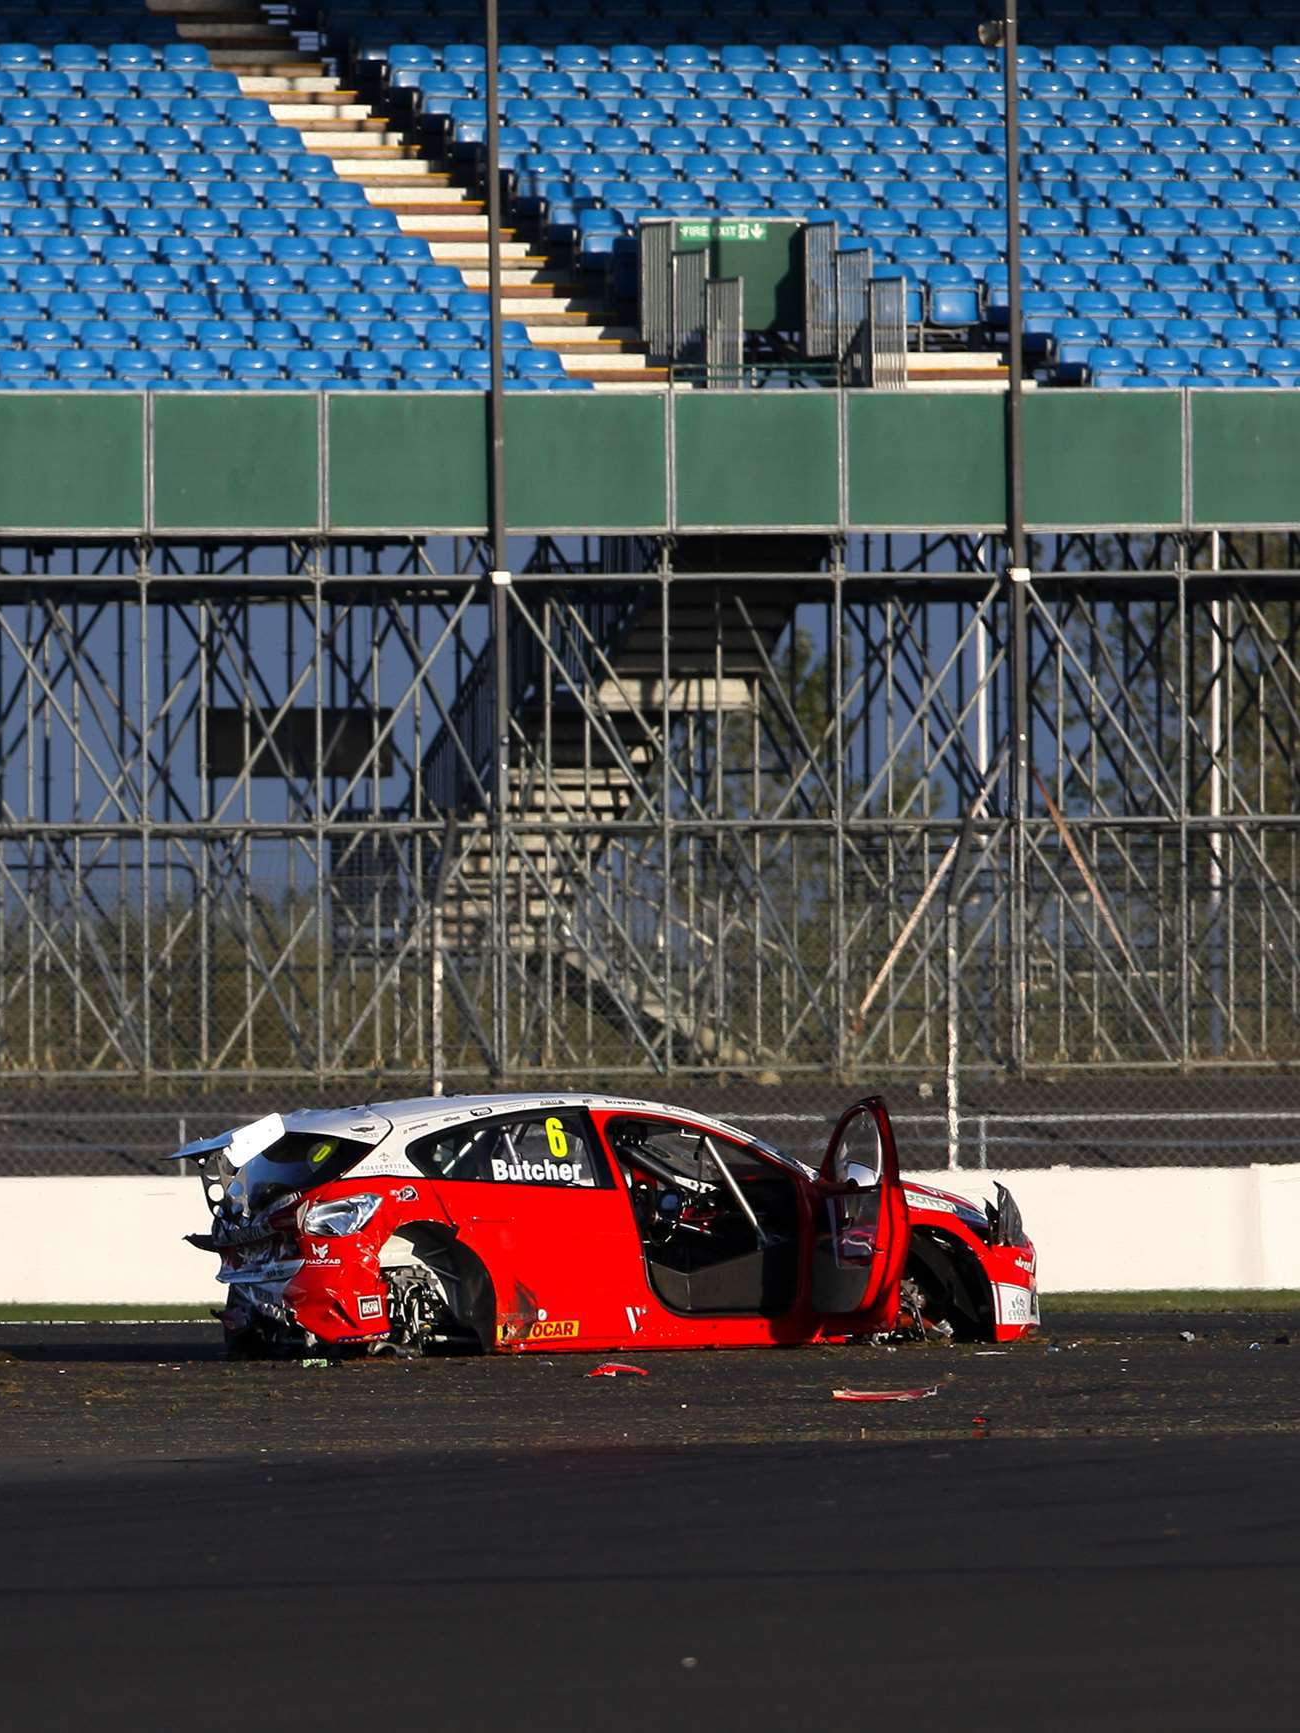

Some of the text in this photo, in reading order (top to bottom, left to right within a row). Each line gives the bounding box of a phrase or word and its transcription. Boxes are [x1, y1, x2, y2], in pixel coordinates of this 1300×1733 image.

[681, 225, 710, 237] FIRE
[545, 1117, 568, 1158] 6
[491, 1159, 582, 1181] Butcher
[531, 1321, 575, 1338] OCAR
